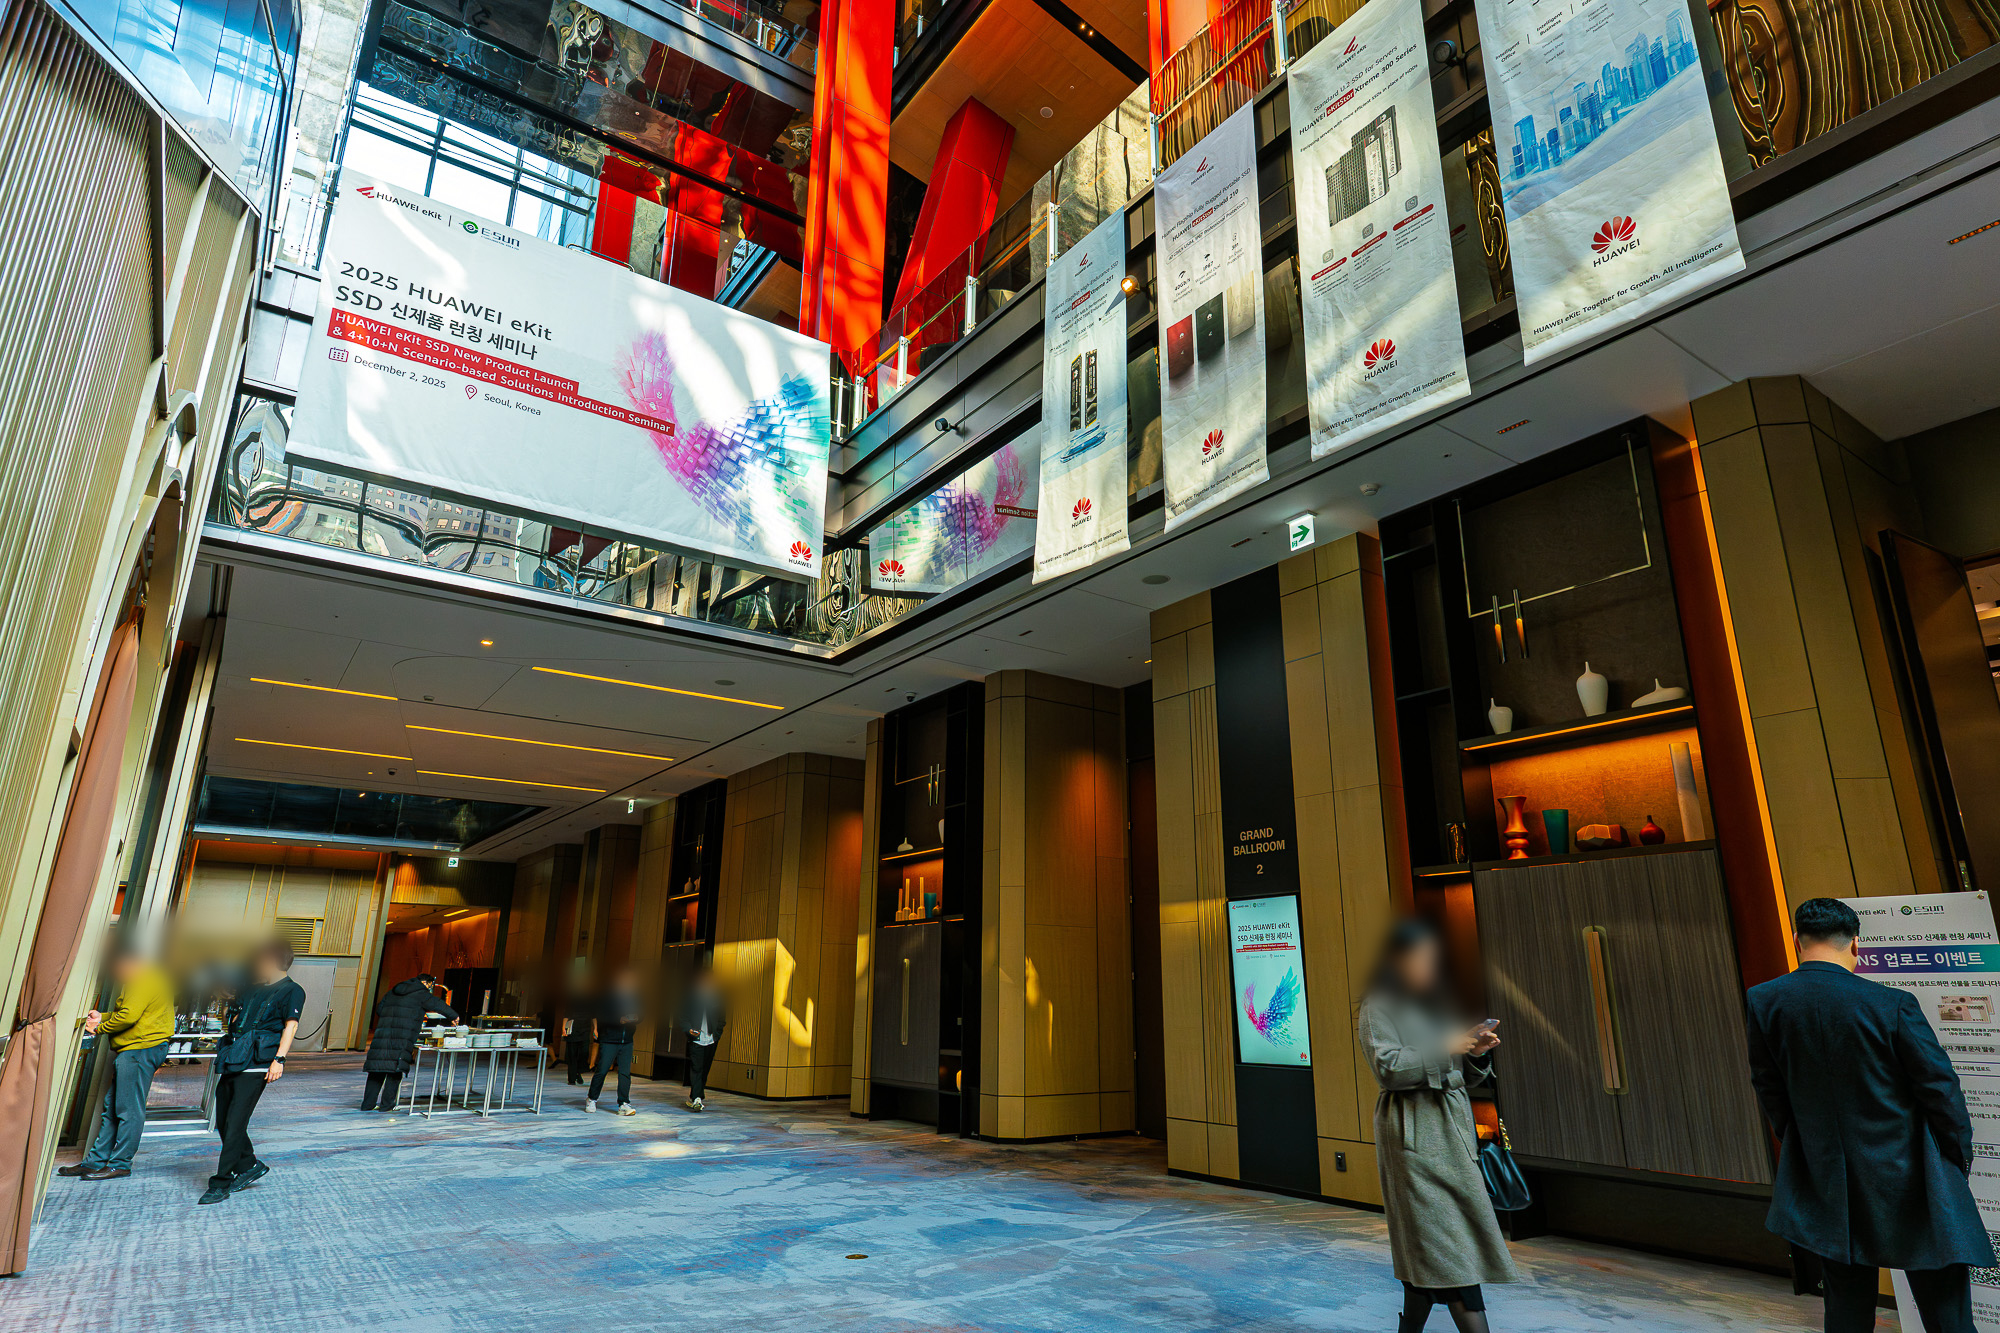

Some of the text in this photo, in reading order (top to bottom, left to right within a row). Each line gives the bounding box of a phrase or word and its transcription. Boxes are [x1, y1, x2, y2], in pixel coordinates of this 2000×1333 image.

[1537, 12, 1562, 32] Intelligent
[1540, 19, 1561, 36] Business
[1495, 41, 1520, 60] Intelligent
[1501, 50, 1516, 63] Office
[1336, 53, 1356, 70] HUAWEI
[1300, 112, 1326, 135] HUAWEI
[1382, 61, 1393, 74] 300
[1396, 44, 1417, 63] Series
[1314, 90, 1338, 113] Standard
[1352, 71, 1363, 84] SSD
[1365, 64, 1374, 74] for
[1376, 46, 1398, 66] Servers
[376, 192, 419, 212] HUAWEI
[422, 208, 442, 220] eKit
[1172, 224, 1191, 242] HUAWEI
[1229, 189, 1239, 199] 210
[1593, 239, 1640, 267] HUAWEI
[1533, 242, 1723, 335] HUAWEI eKit: Together for Growth, All Intelligence
[340, 261, 552, 341] 2025 HUAWEI eKit
[336, 286, 538, 361] SSD 신제품 런칭 세미나
[335, 312, 574, 392] HUAWEI eKit SSD New Product Launch
[332, 326, 671, 433] & 4+10+N Scenario-based Solutions Introduction Seminar
[354, 355, 447, 389] December 2, 2025
[1364, 360, 1398, 381] HUAWEI
[484, 392, 541, 417] Seoul, Korea
[1320, 423, 1341, 435] HUAWEI
[1355, 406, 1378, 419] Together
[1388, 392, 1411, 404] Growth,
[1422, 371, 1456, 389] Intelligence
[1201, 447, 1224, 465] HUAWEI
[1072, 516, 1091, 528] HUAWEI
[788, 558, 812, 569] HUAWEI
[1239, 827, 1273, 842] GRAND
[1233, 840, 1285, 856] BALLROOM
[1256, 864, 1263, 875] 2
[1889, 934, 1905, 942] eKit
[1924, 933, 1947, 941] 신제품
[1967, 932, 1992, 940] 세미나
[1857, 952, 1984, 967] NS 업로드 이벤트
